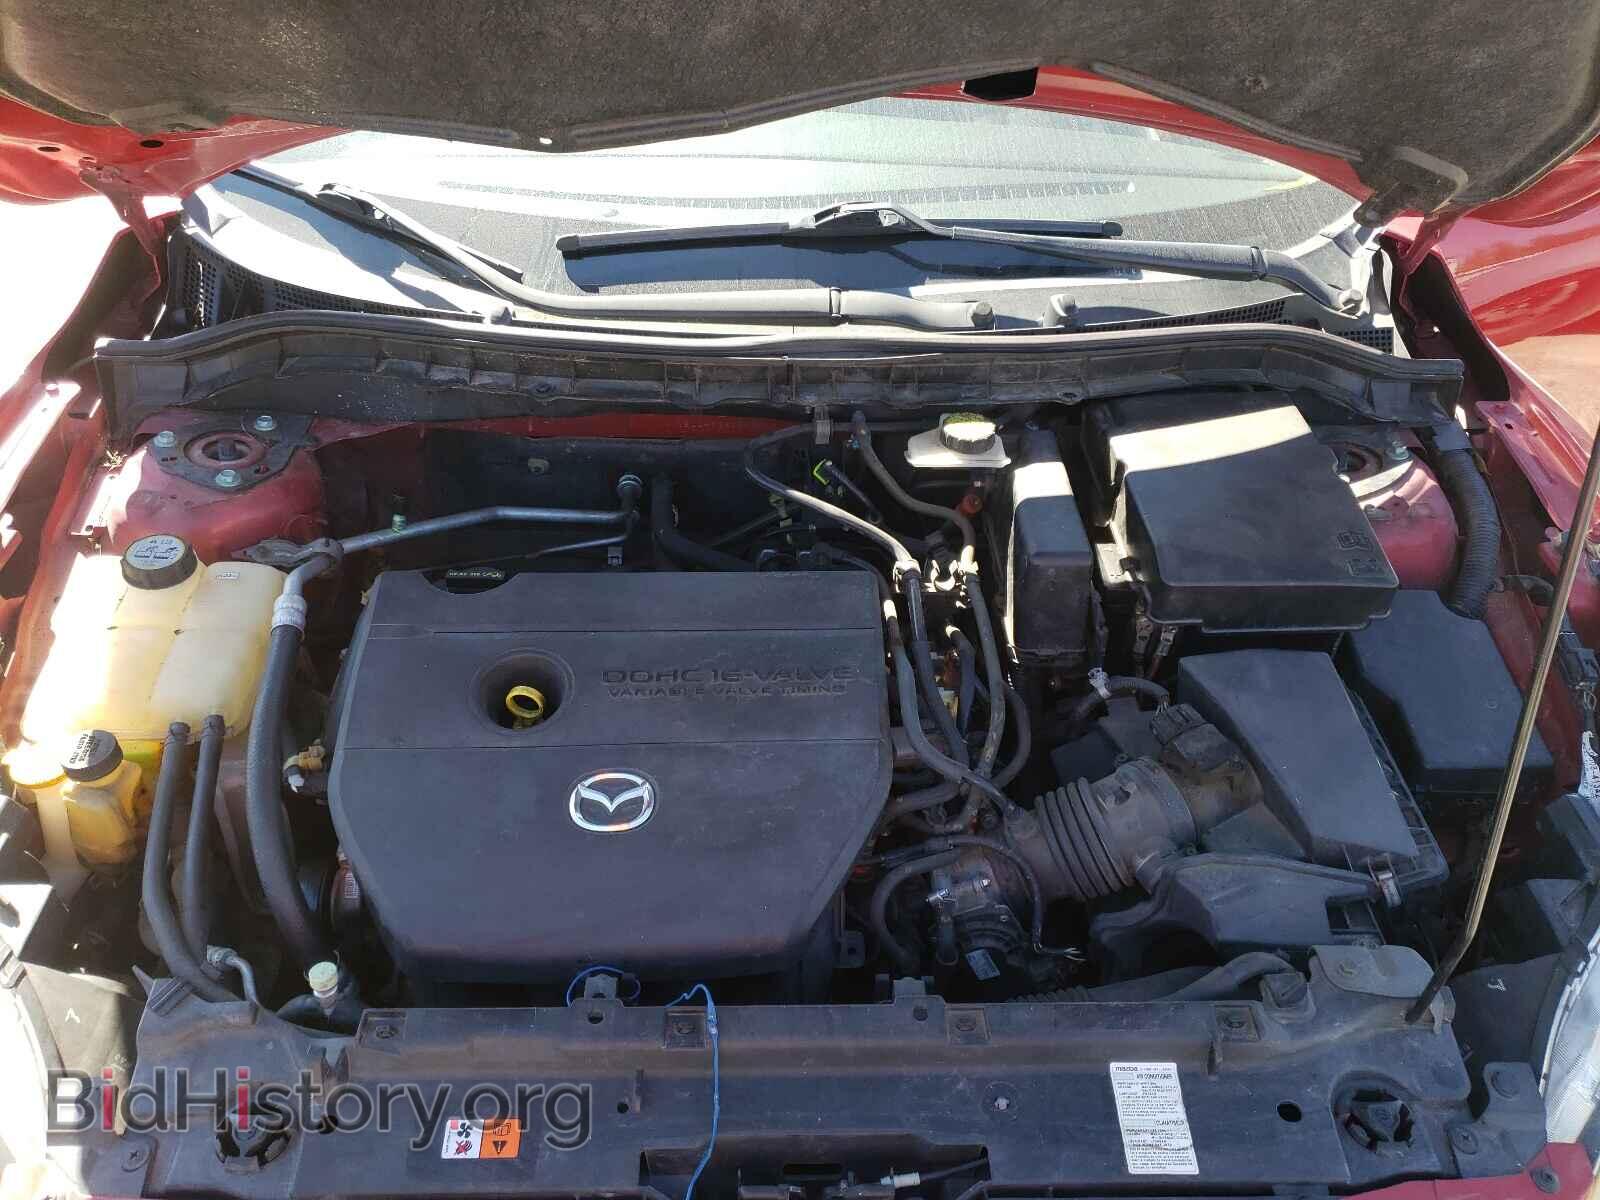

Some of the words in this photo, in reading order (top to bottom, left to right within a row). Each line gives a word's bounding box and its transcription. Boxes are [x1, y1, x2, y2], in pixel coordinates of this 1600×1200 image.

[602, 668, 701, 684] DOHC
[711, 666, 854, 683] 16-VALVE
[607, 686, 705, 697] VARIABLE
[712, 686, 771, 697] VALVE
[781, 685, 847, 696] TIMING
